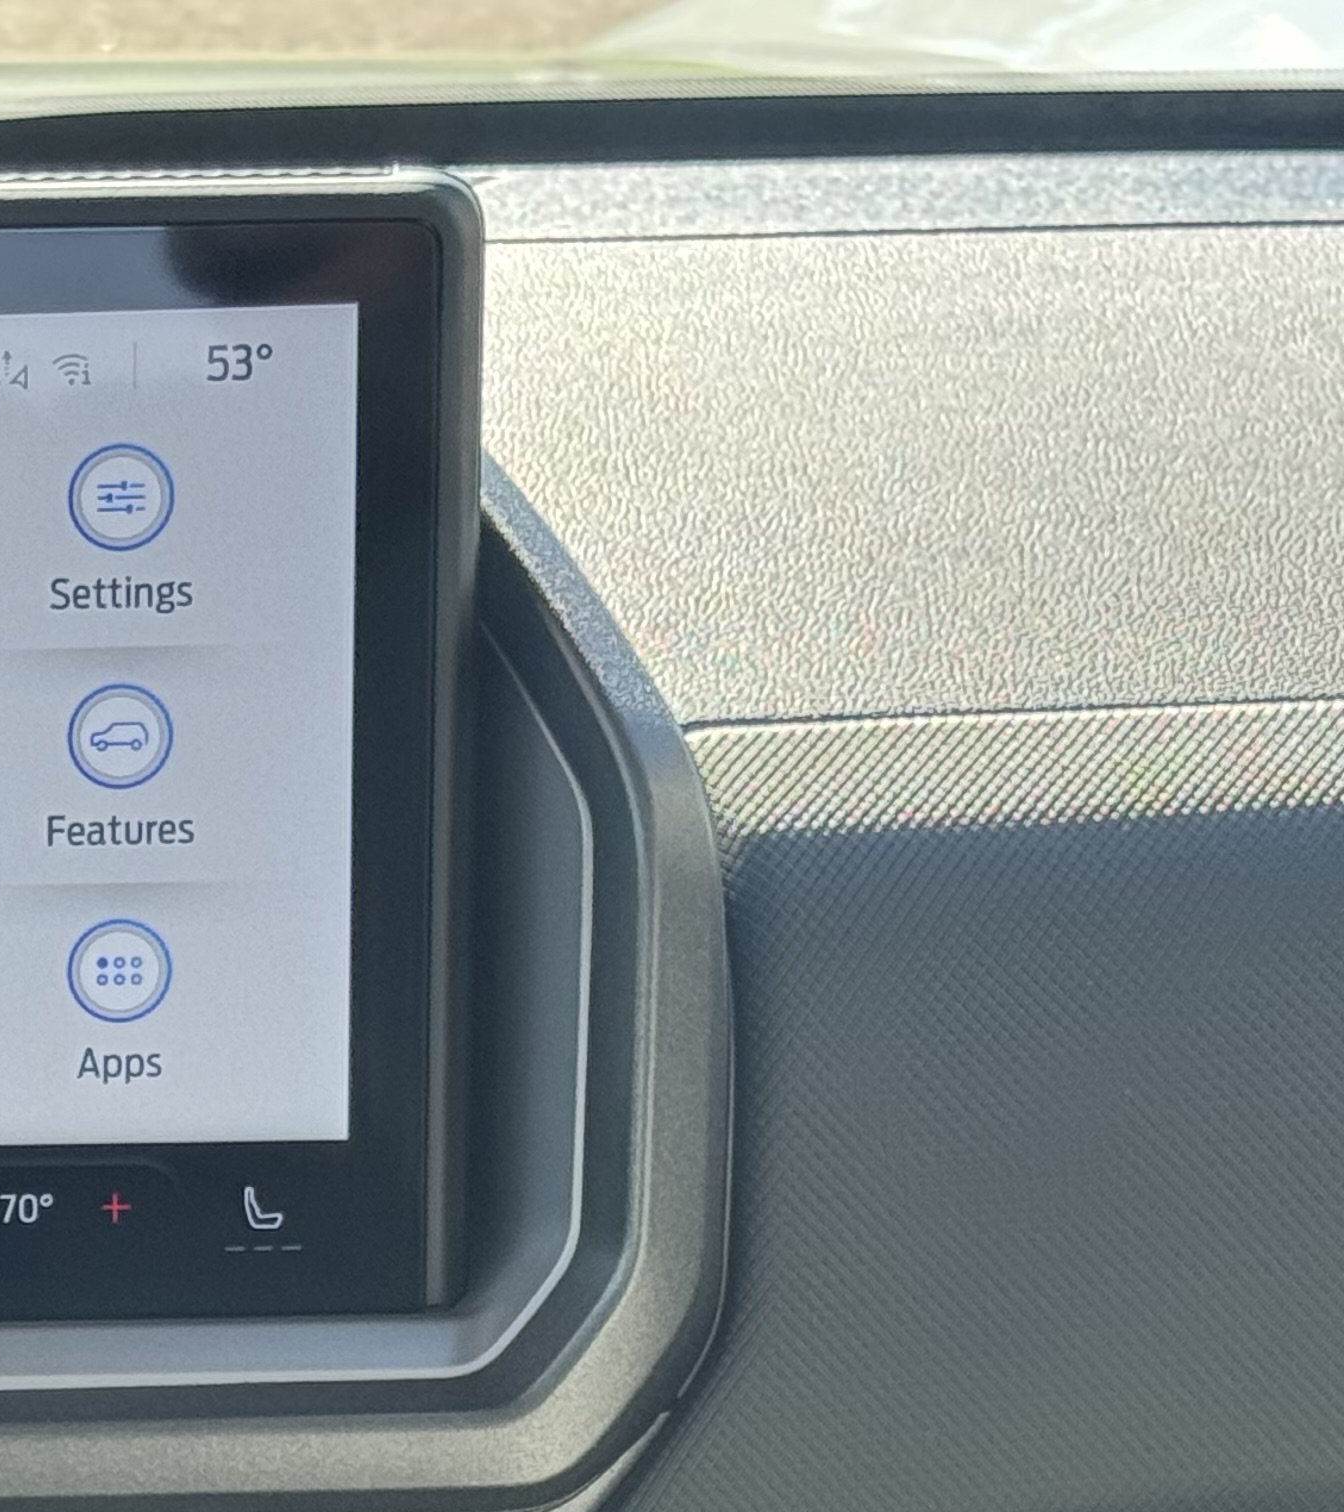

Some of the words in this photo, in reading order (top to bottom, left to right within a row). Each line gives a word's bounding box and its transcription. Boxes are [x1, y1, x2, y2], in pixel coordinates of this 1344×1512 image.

[206, 343, 274, 382] 53°
[50, 575, 193, 614] Settings
[47, 814, 195, 847] Features
[76, 1047, 162, 1085] Apps
[0, 1193, 54, 1224] 70°
